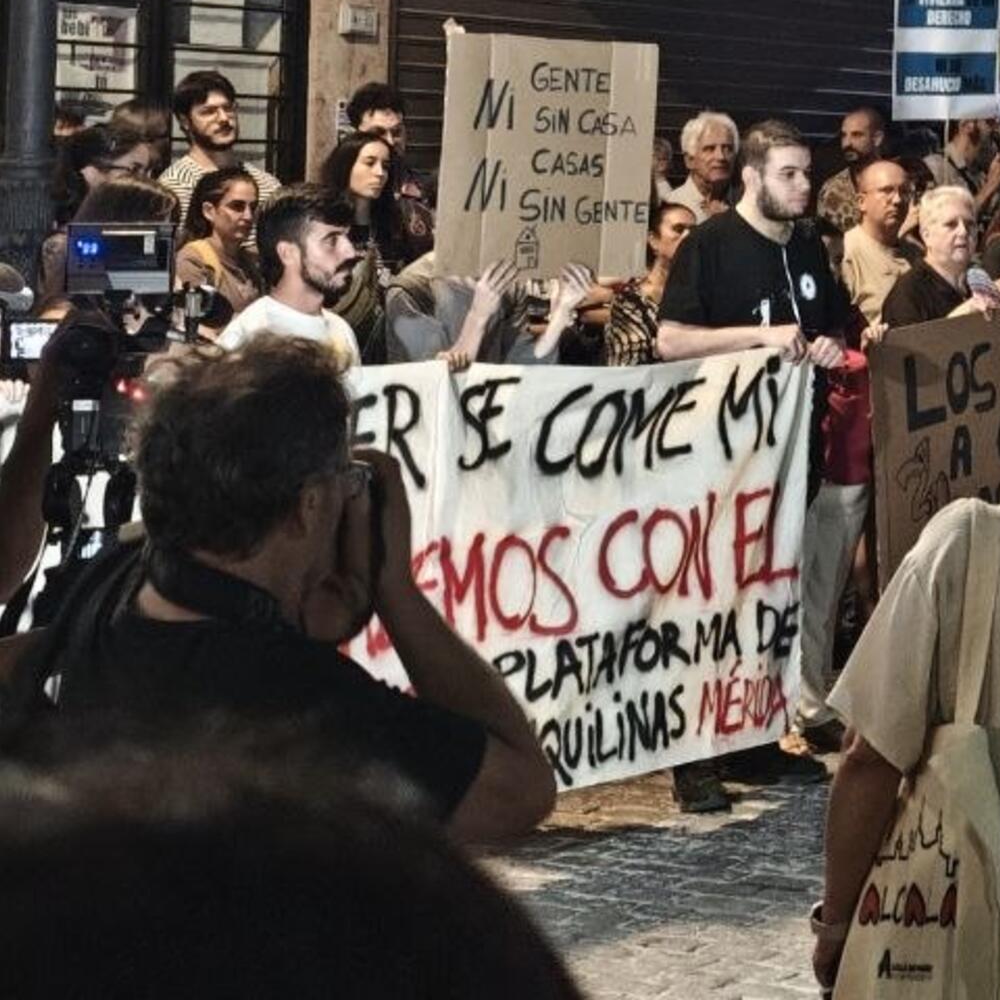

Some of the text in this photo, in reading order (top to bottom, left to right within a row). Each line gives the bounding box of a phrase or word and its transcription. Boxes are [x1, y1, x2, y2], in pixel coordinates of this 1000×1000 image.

[530, 62, 611, 93] GENTE
[578, 109, 637, 137] CASA
[531, 149, 604, 178] CASAS
[575, 196, 648, 225] GENTE
[904, 342, 997, 433] LOS
[457, 377, 521, 471] SE
[535, 377, 707, 479] COME
[599, 491, 717, 600] CON
[732, 480, 798, 591] EL
[756, 600, 799, 658] DE
